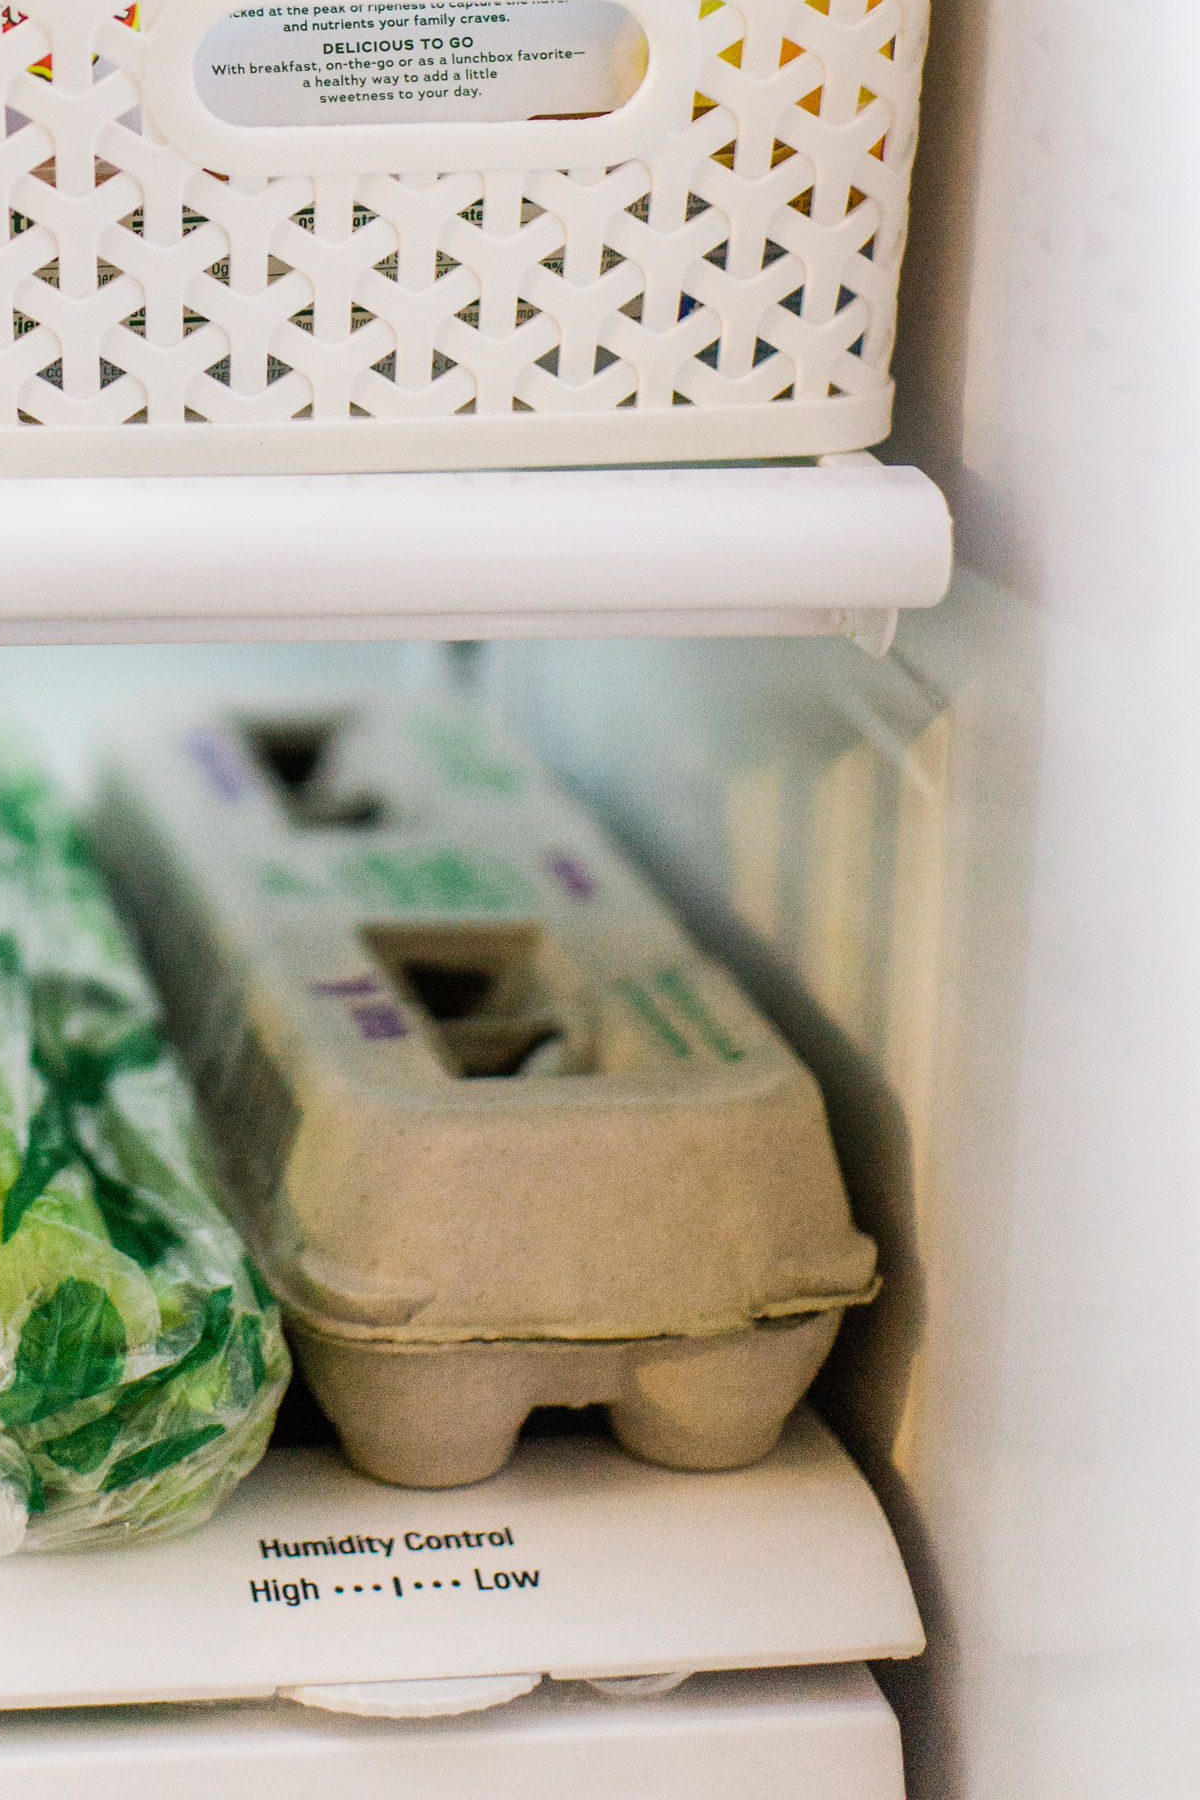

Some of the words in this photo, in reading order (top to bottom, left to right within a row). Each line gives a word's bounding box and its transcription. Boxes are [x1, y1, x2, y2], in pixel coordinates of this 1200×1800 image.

[269, 7, 283, 17] at
[287, 5, 309, 16] the
[314, 4, 346, 18] peak
[283, 20, 308, 32] and
[312, 17, 375, 32] nutrients
[379, 17, 410, 30] your
[414, 13, 456, 27] family
[460, 13, 511, 25] craves.
[323, 39, 415, 55] DELICIOUS
[420, 38, 444, 50] TO
[449, 36, 474, 49] GO
[212, 63, 246, 76] With
[249, 60, 322, 75] breakfast,
[326, 57, 395, 71] on-the-go
[398, 57, 413, 67] or
[418, 57, 434, 66] as
[439, 57, 448, 66] a
[452, 51, 514, 66] lunchbox
[302, 78, 311, 88] a
[315, 75, 367, 89] healthy
[372, 76, 399, 87] way
[404, 72, 419, 84] to
[423, 70, 448, 82] add
[452, 72, 461, 81] a
[465, 68, 498, 80] little
[319, 91, 394, 104] sweetness
[398, 89, 414, 99] to
[418, 88, 449, 101] your
[453, 85, 483, 98] day.
[259, 1533, 394, 1558] Humidity
[403, 1526, 515, 1552] Control
[249, 1576, 320, 1606] High
[473, 1567, 540, 1591] Low
